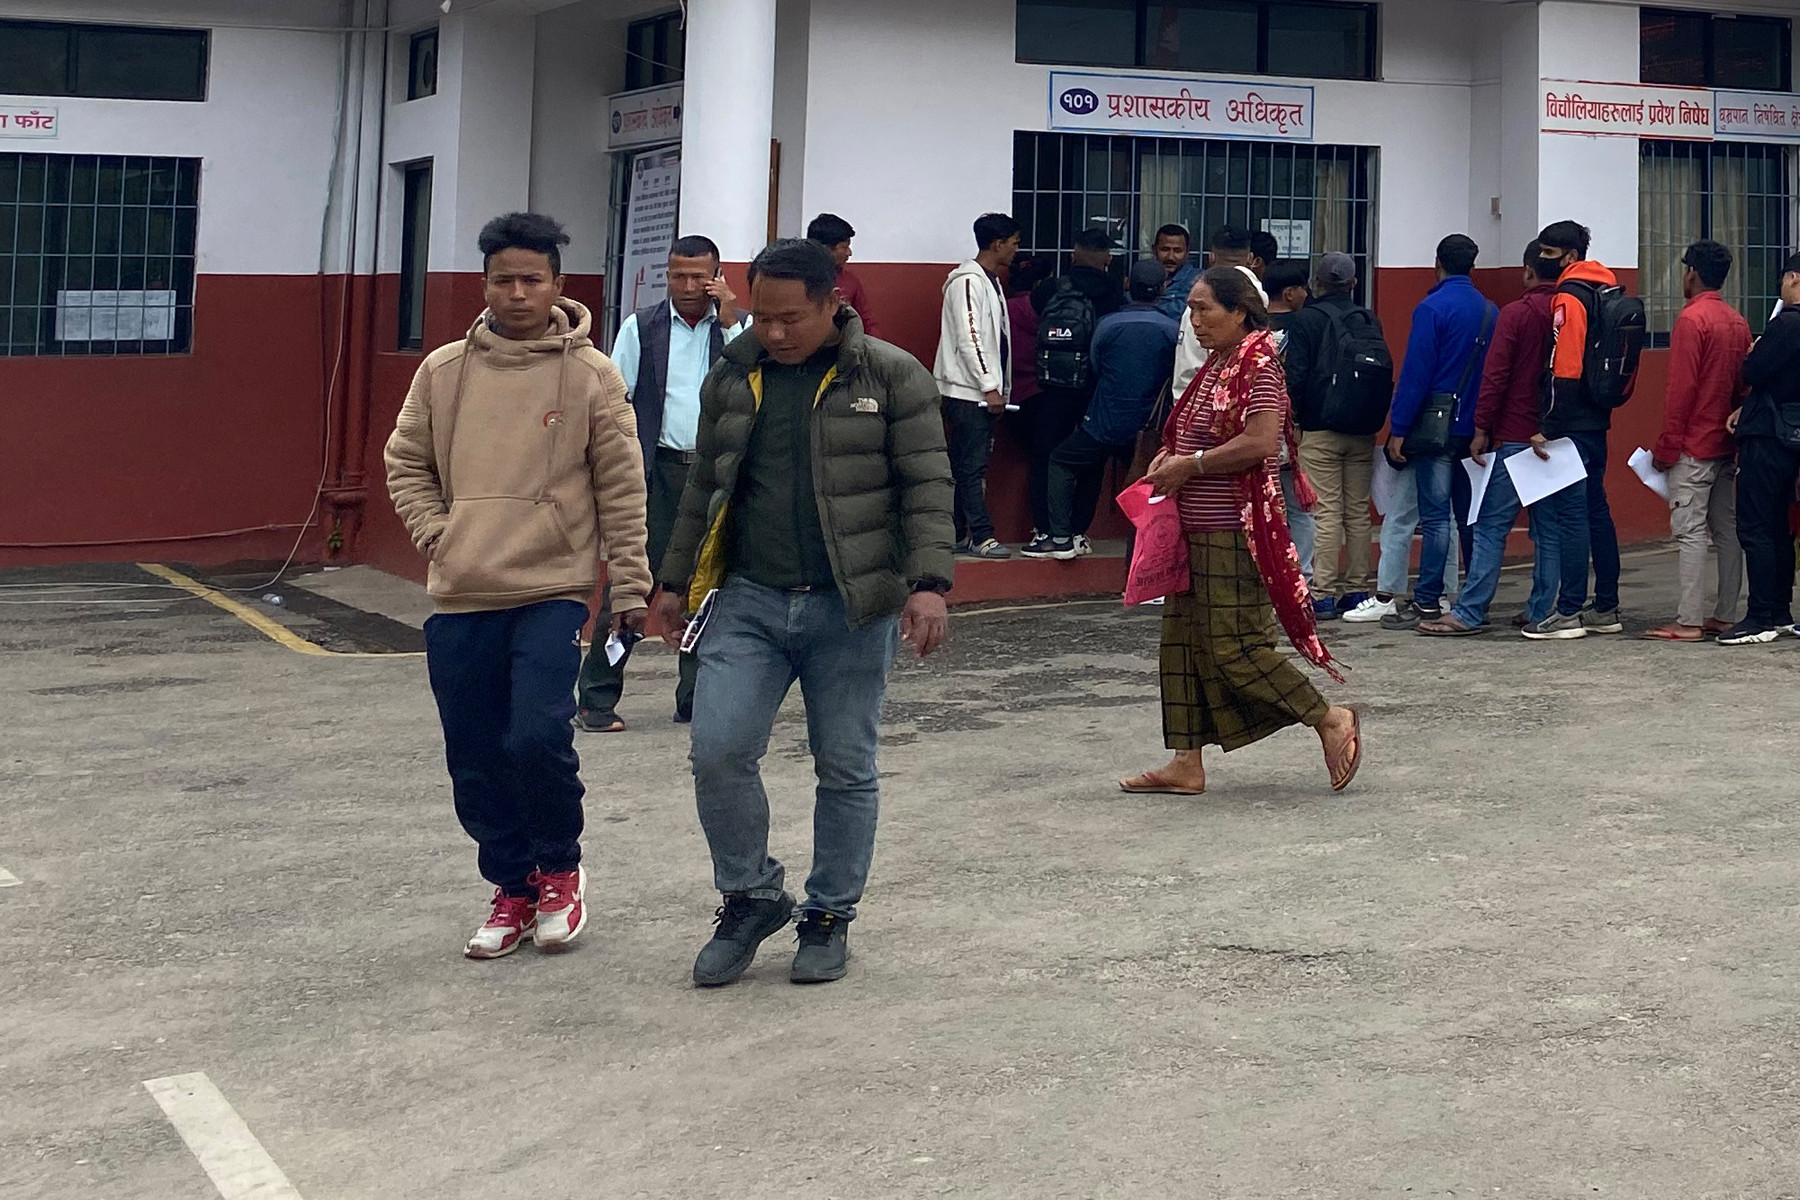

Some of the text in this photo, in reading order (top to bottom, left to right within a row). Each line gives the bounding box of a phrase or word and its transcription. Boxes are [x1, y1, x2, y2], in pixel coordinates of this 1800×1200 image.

[15, 111, 52, 128] फाँट
[1063, 88, 1304, 133] १०१ प्रशासकीय अधिकृत
[1650, 100, 1674, 123] प्रवेश
